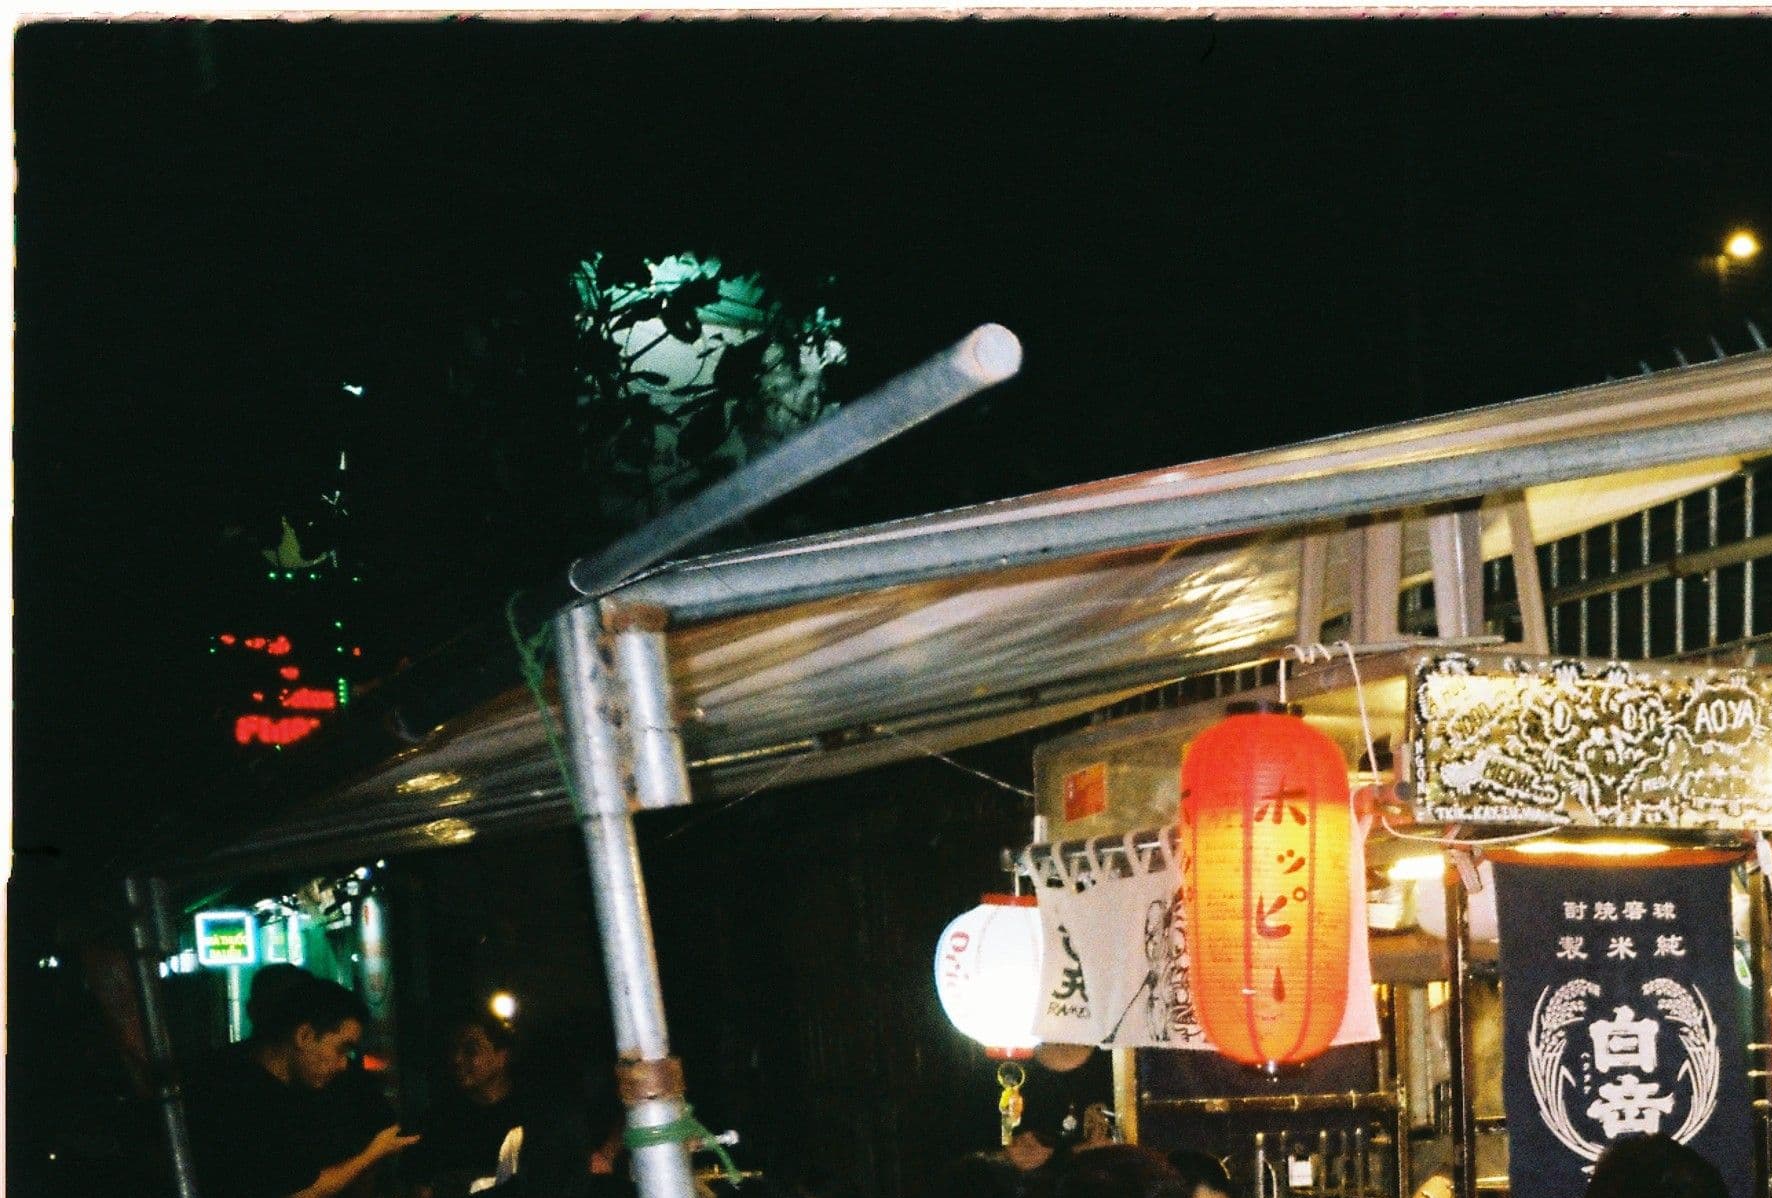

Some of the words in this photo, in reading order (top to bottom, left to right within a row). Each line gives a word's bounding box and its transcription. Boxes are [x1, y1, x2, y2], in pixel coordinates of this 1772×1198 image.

[1695, 699, 1755, 734] AOYA
[1254, 779, 1307, 1003] ホッピー
